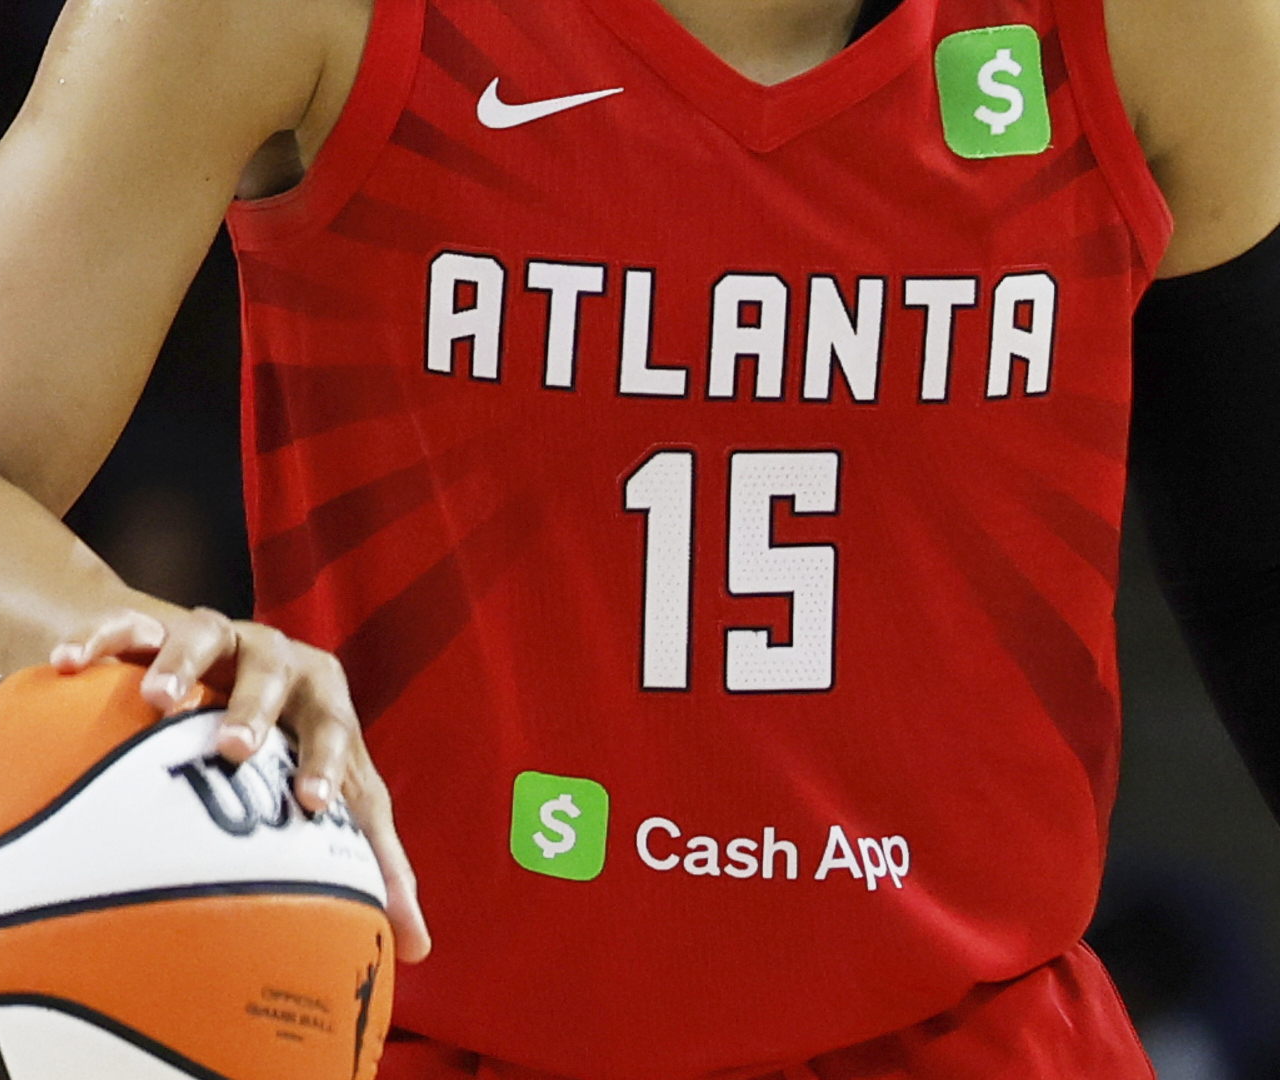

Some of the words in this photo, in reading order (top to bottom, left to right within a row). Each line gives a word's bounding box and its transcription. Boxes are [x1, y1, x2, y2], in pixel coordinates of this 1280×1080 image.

[973, 48, 1025, 135] $
[425, 250, 1058, 404] ATLANTA
[623, 449, 841, 694] 15
[636, 817, 798, 880] Cash
[814, 825, 910, 891] App
